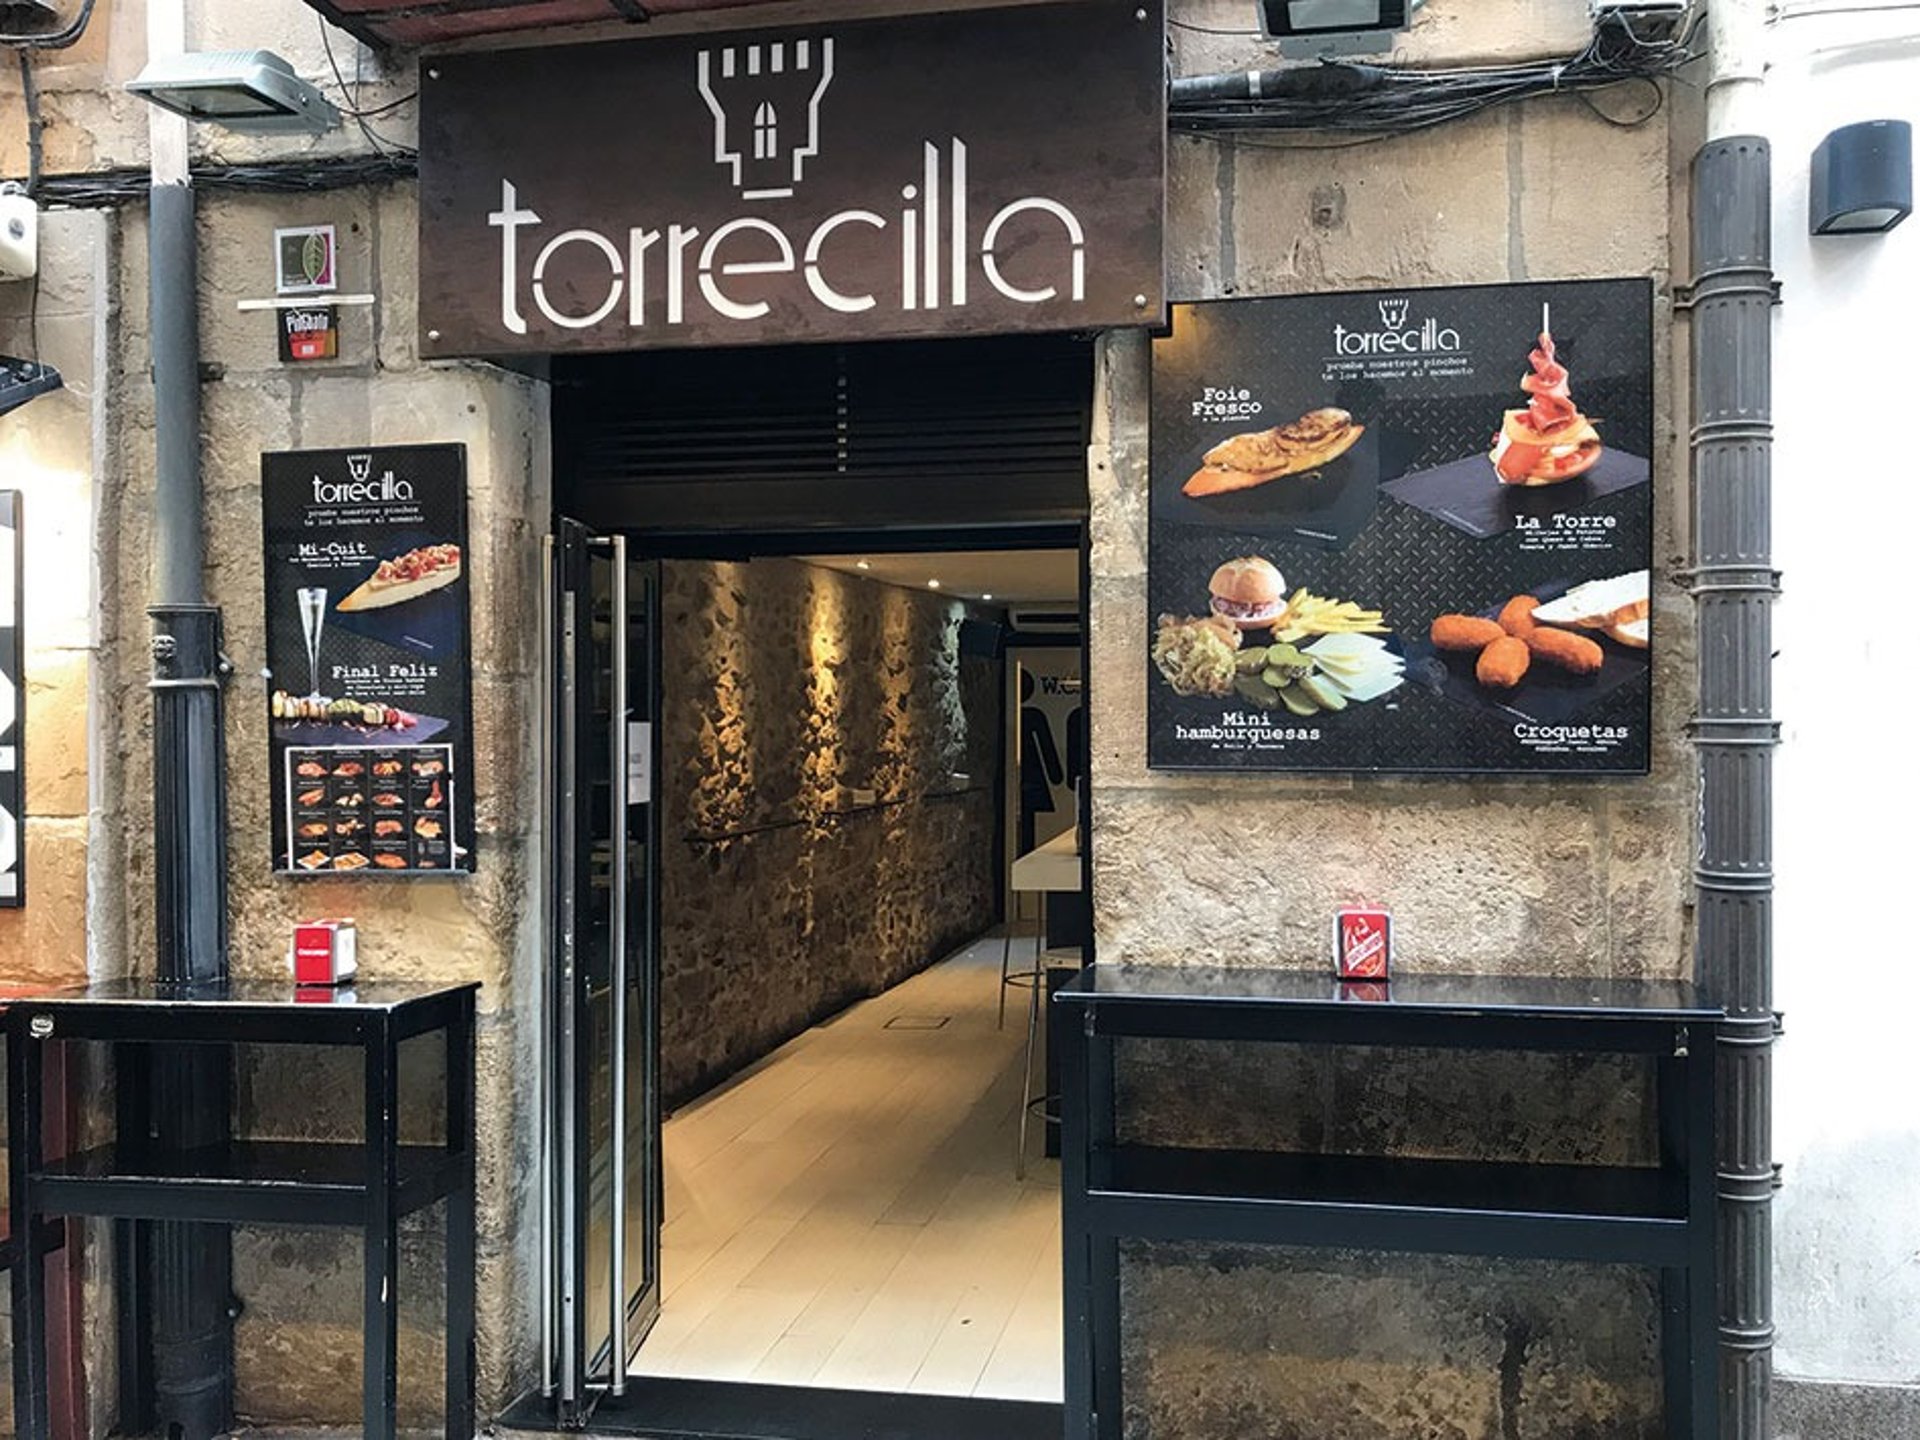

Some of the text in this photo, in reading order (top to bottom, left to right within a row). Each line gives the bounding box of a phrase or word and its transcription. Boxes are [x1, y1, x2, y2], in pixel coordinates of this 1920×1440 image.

[487, 136, 1085, 334] torrecilla
[1333, 317, 1461, 355] torrecilla
[1203, 385, 1251, 402] Foie
[1191, 401, 1263, 417] Fresco
[312, 471, 414, 504] torrecilla
[1515, 513, 1617, 529] La Torre
[299, 541, 368, 557] Mi-Cuit
[332, 662, 439, 680] Final Feliz
[1222, 710, 1272, 726] Mini
[1175, 724, 1321, 744] hamburguesas
[1513, 722, 1629, 742] Croquetas
